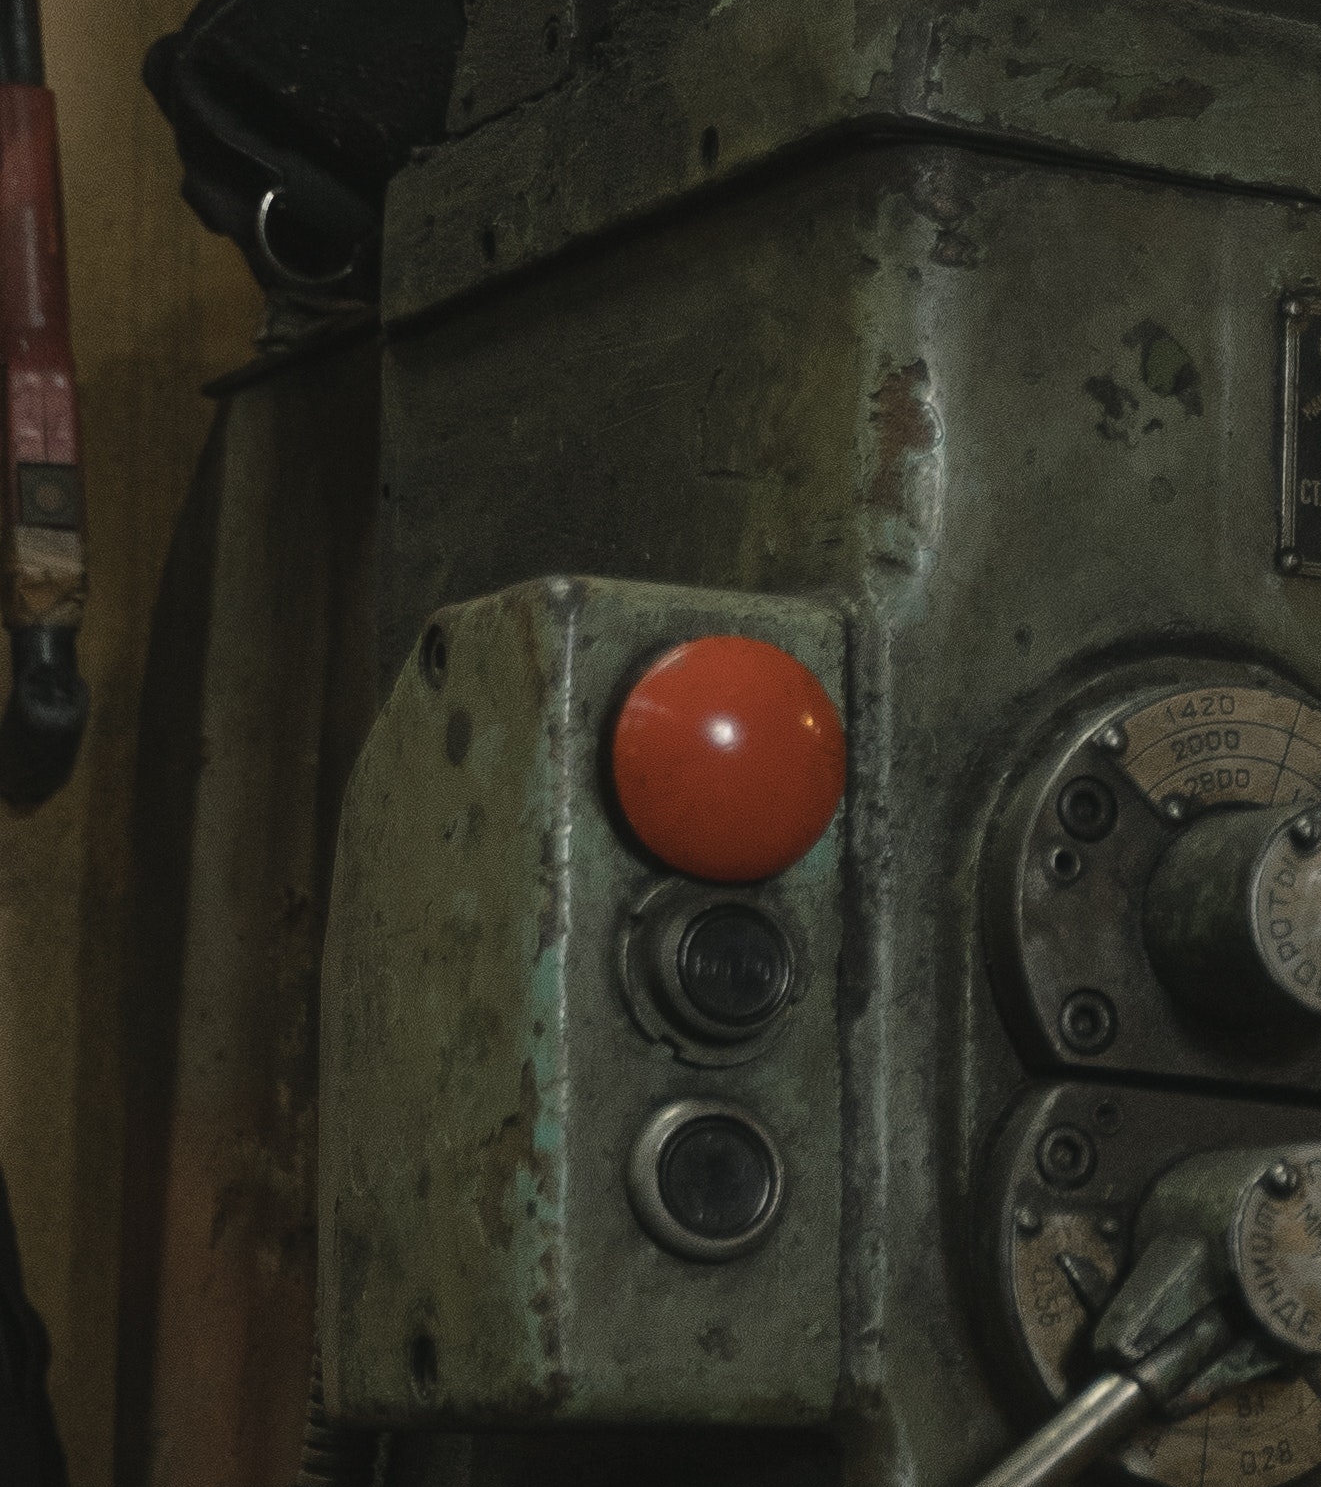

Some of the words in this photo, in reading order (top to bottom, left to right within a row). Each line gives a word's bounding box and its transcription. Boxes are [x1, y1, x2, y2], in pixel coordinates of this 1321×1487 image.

[1163, 694, 1236, 724] 1420
[1170, 728, 1241, 762] 2000
[1184, 768, 1251, 800] 2800
